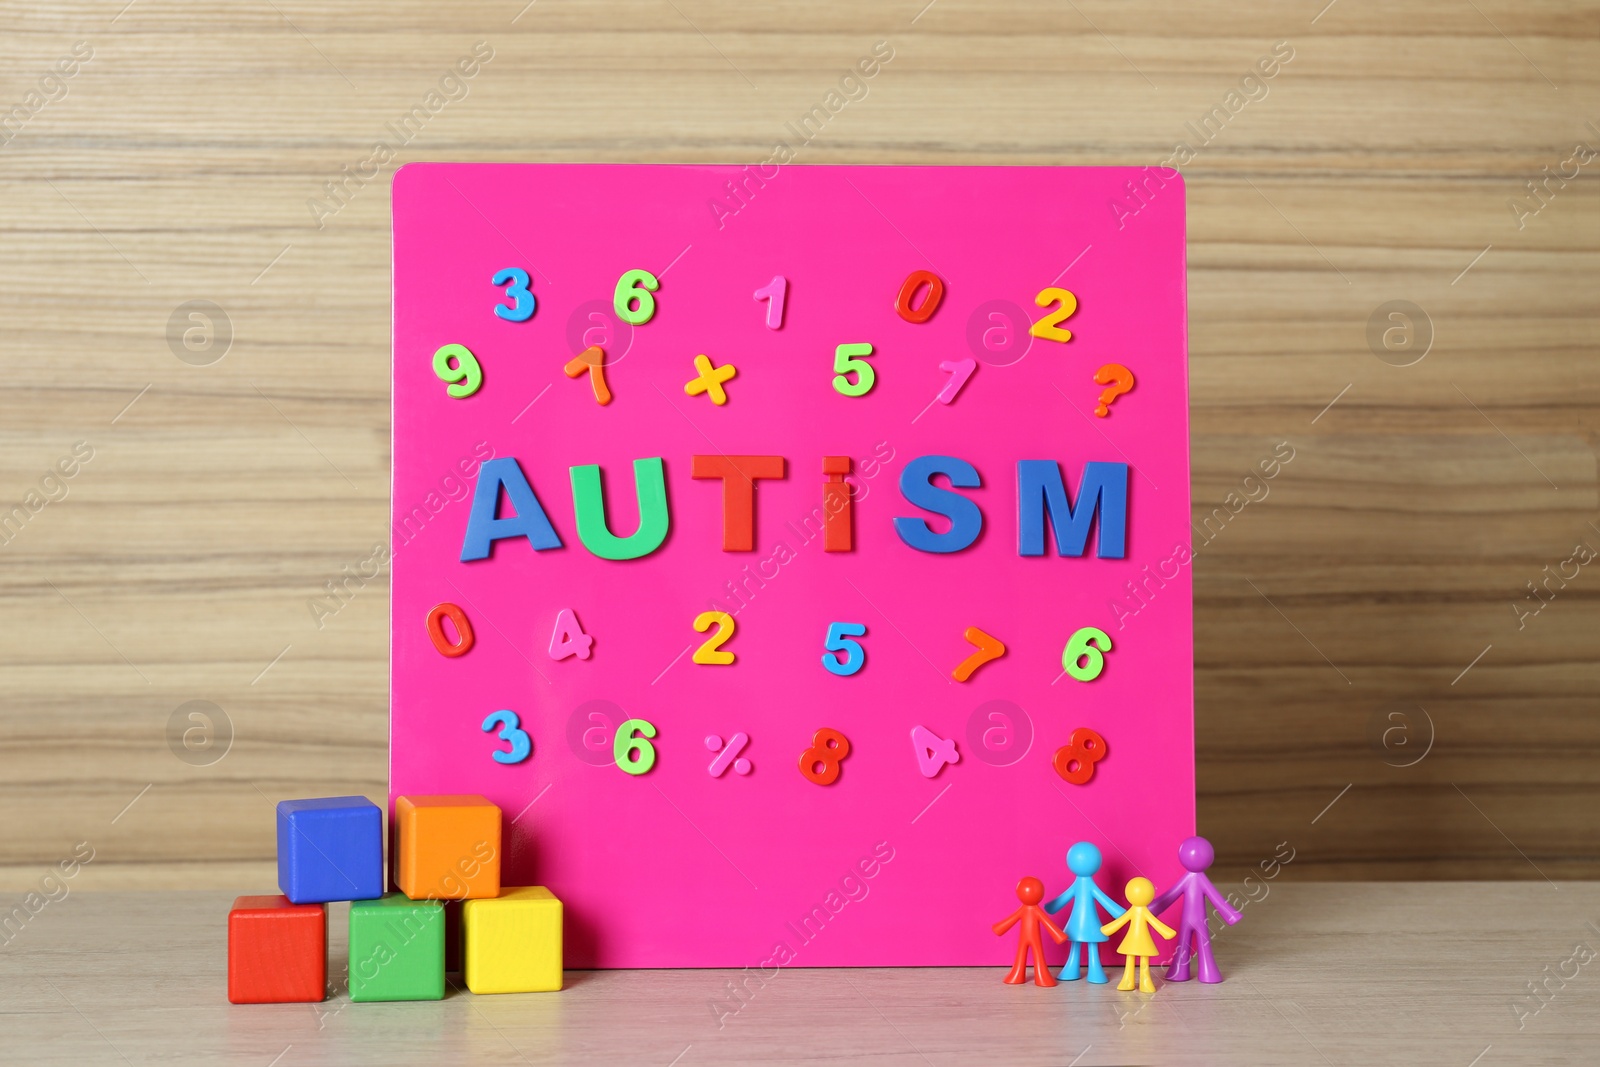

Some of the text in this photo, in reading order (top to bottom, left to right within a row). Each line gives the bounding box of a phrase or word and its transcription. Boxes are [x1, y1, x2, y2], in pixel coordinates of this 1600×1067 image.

[492, 267, 1077, 343] 3 6 1 0 2
[432, 344, 482, 399] 9
[832, 343, 875, 397] 5
[1093, 363, 1135, 418] ?
[425, 602, 1112, 682] 0 4 2 5 7 6
[481, 709, 530, 764] 3
[613, 718, 656, 775] 6
[798, 728, 850, 785] 8
[911, 725, 960, 778] 4
[1053, 728, 1106, 784] 8
